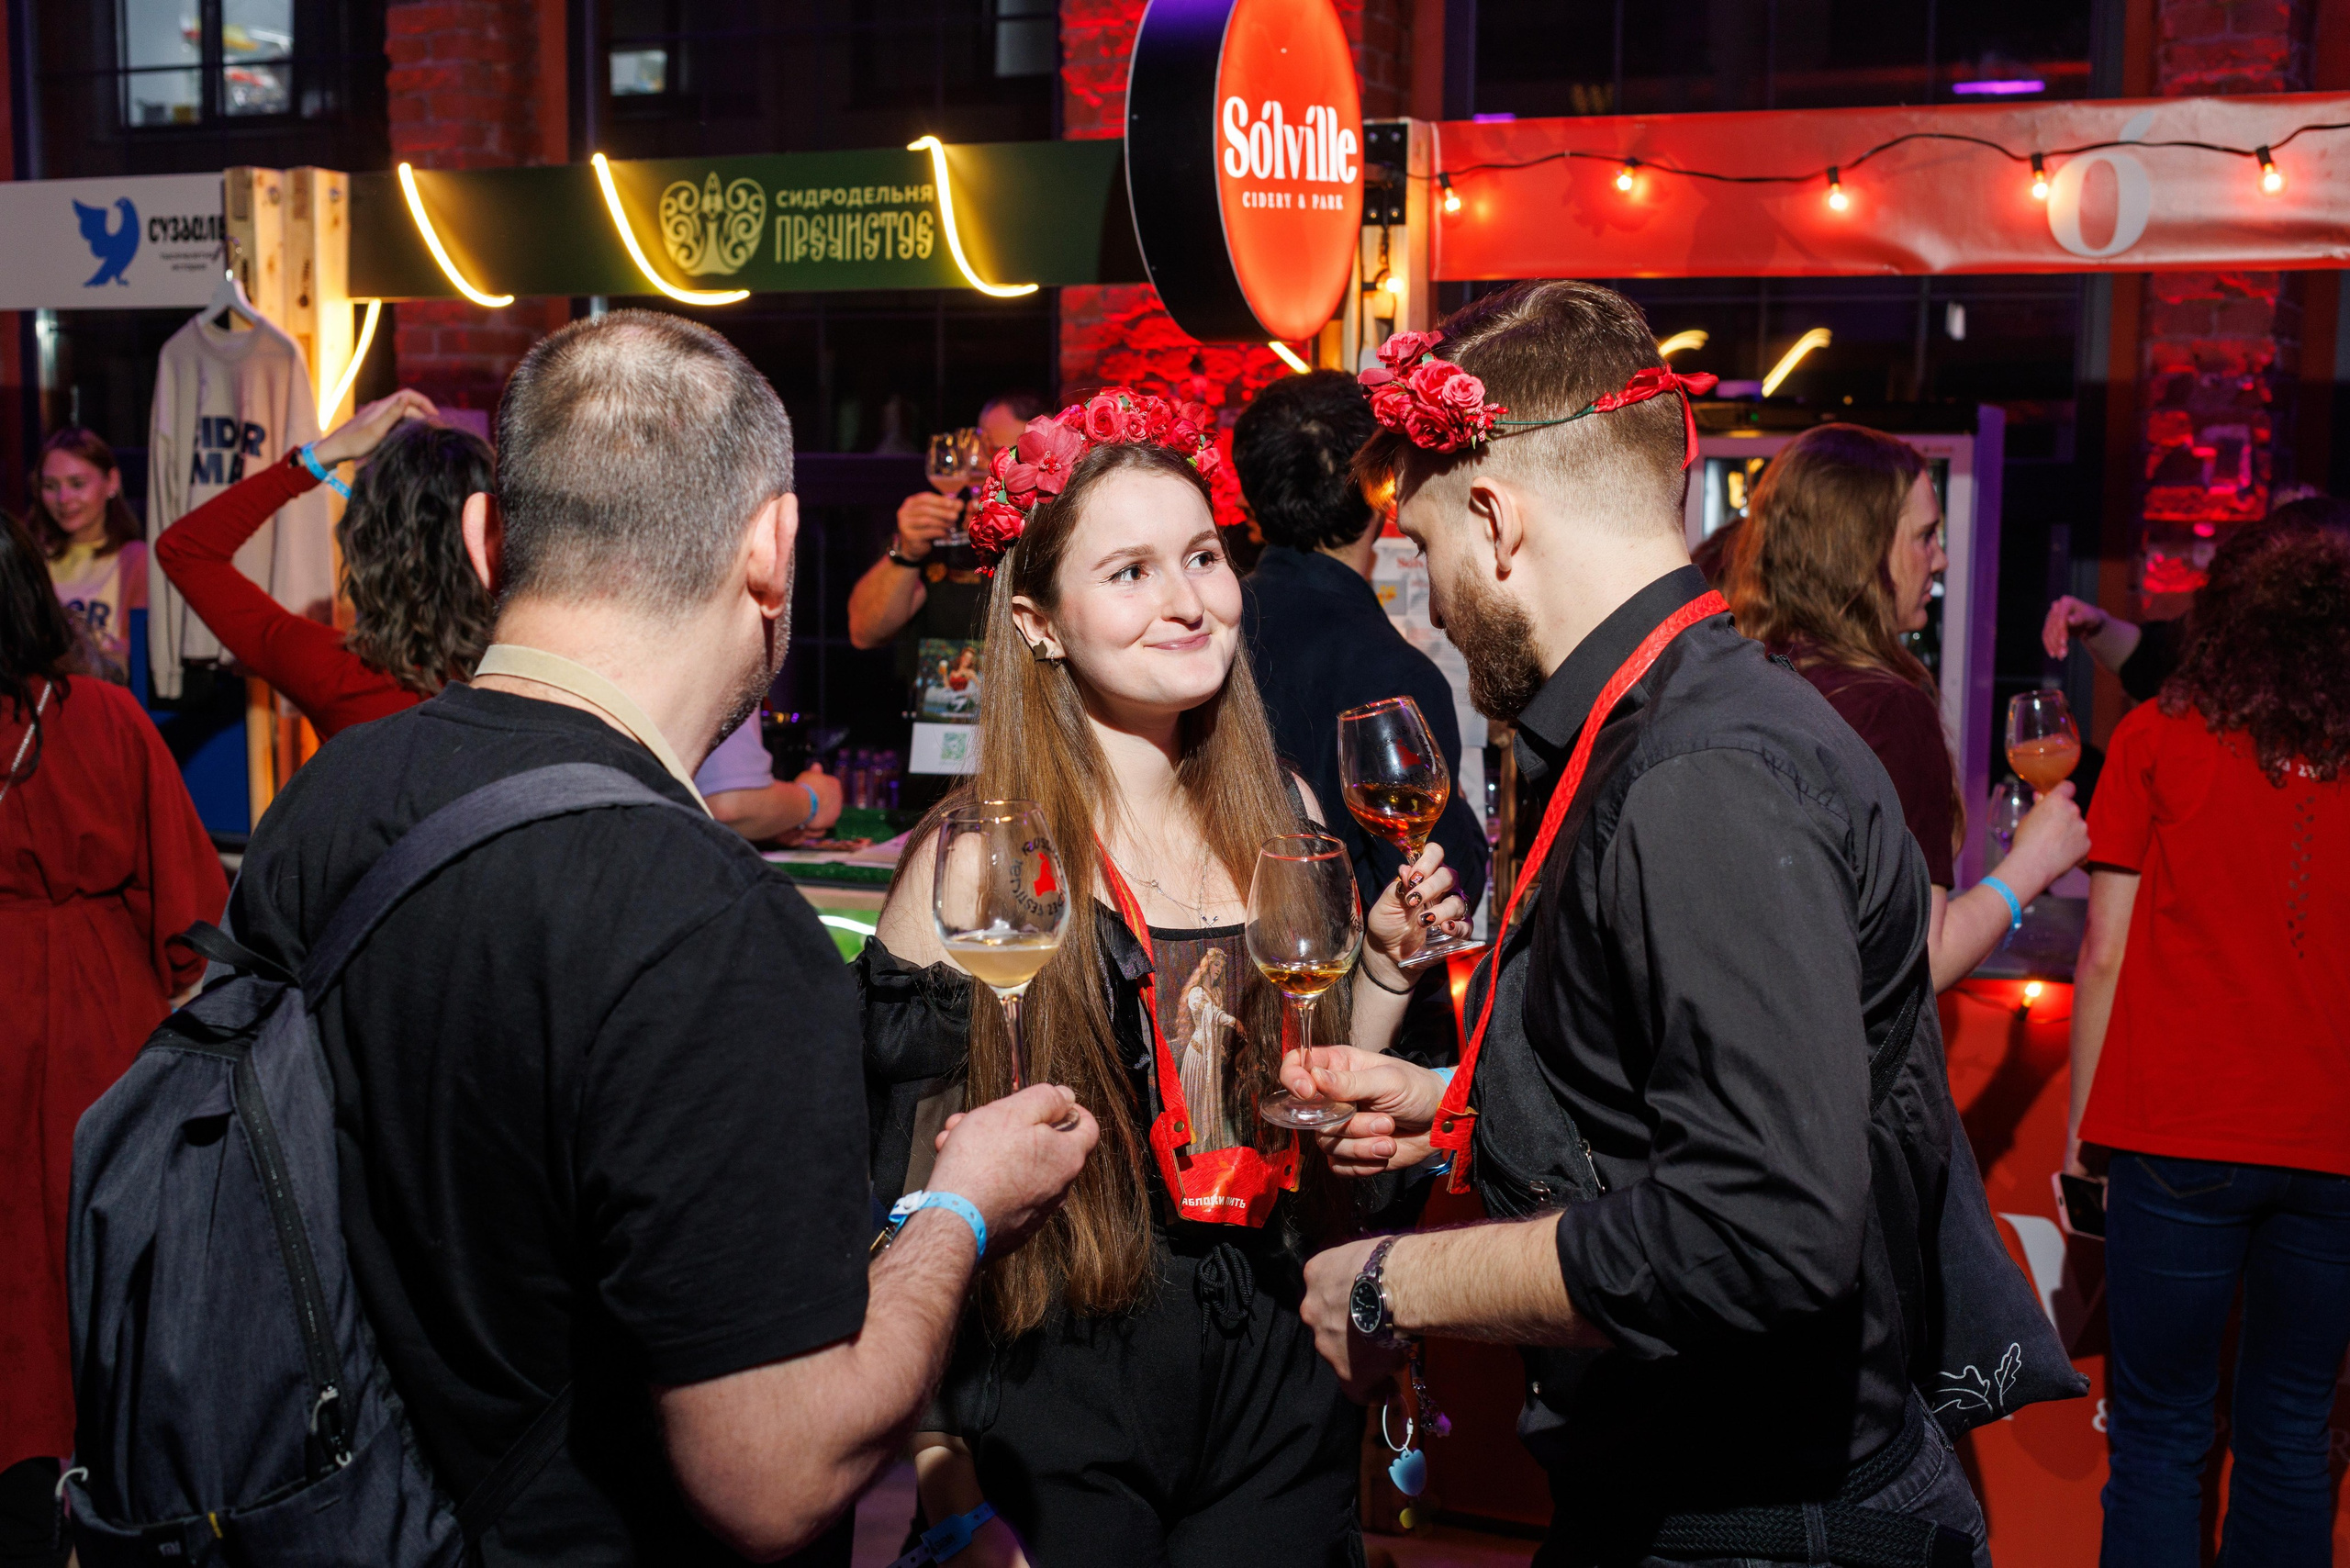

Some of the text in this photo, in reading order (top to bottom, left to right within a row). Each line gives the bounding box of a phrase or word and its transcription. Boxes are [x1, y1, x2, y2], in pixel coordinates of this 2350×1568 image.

[776, 185, 934, 209] СИДРОДЕЛЬНЯ
[1242, 191, 1292, 208] CIDERY
[1313, 193, 1344, 210] PARK
